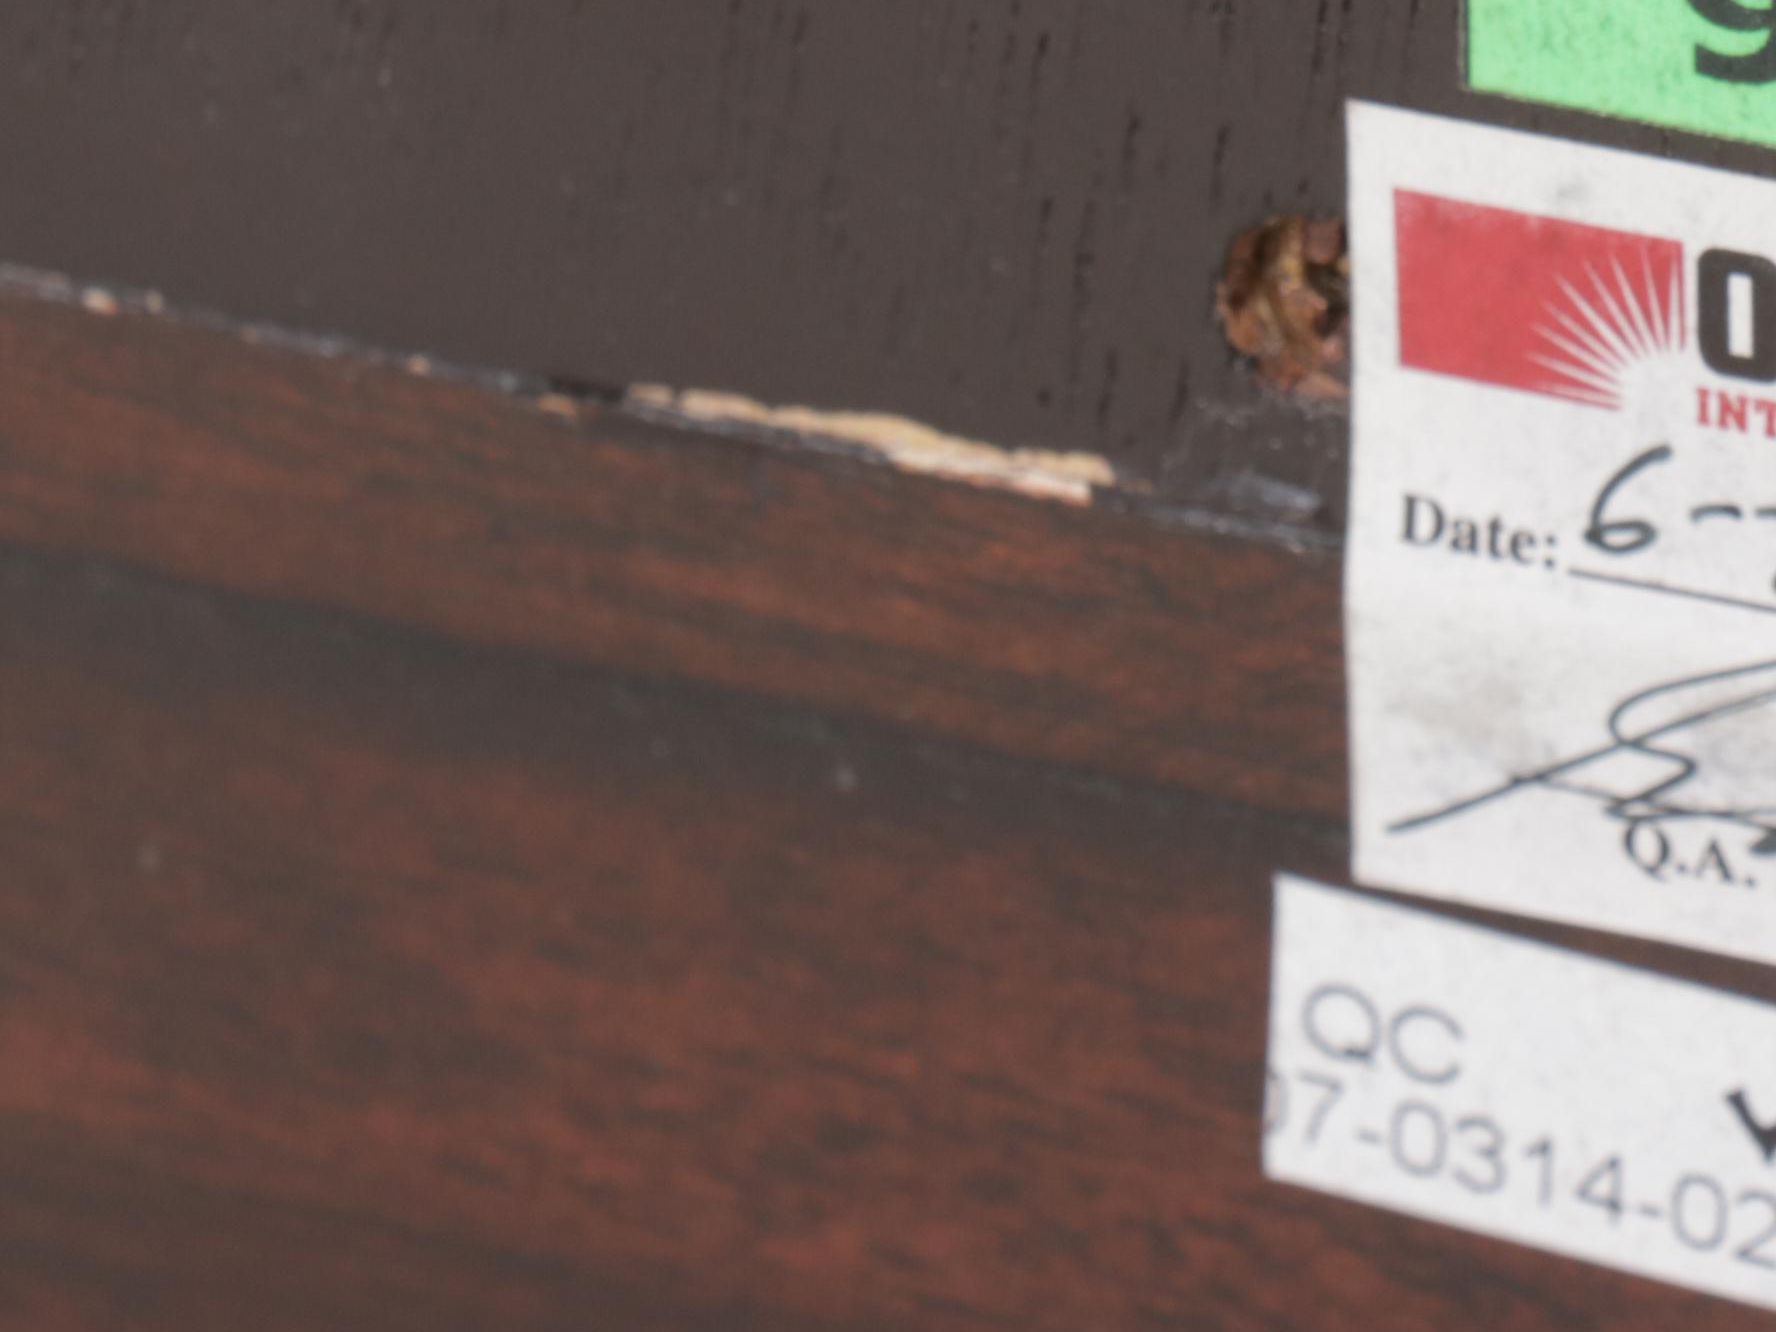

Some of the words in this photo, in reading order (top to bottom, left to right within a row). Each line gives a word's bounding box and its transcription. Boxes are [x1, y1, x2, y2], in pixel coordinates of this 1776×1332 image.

[1398, 493, 1558, 570] Date:
[1622, 816, 1757, 888] Q.A.
[1301, 979, 1466, 1088] QC
